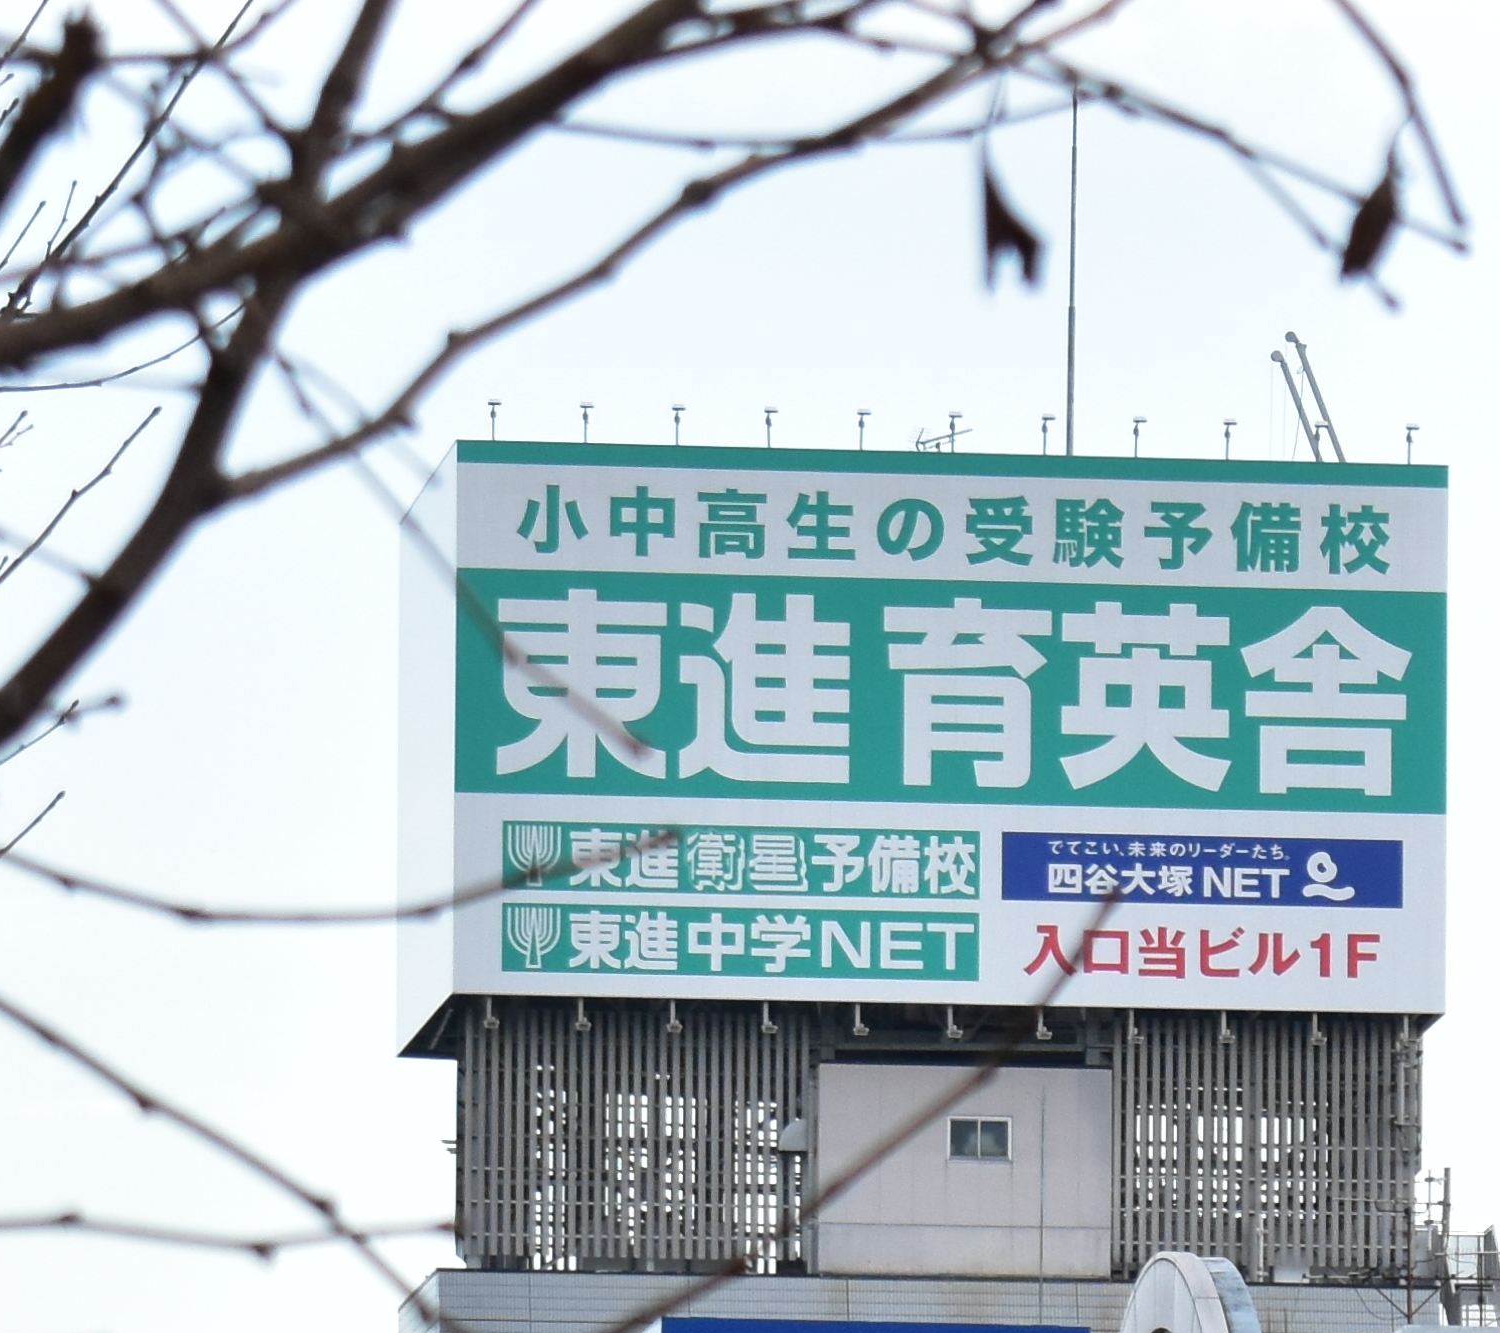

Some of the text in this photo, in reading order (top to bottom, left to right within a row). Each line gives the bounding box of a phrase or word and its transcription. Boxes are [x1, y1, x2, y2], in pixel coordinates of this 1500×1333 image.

[517, 484, 1391, 576] 小中高生の受験予備校
[495, 587, 1414, 796] 東進育英舎
[567, 829, 977, 898] 東進衛星予備校
[1046, 838, 1291, 863] でてこい、未来のリーダーたち。
[1046, 863, 1291, 901] 四谷大塚 NET
[567, 916, 976, 972] 東進中学NET
[1023, 925, 1381, 981] 入口当ビル1F
